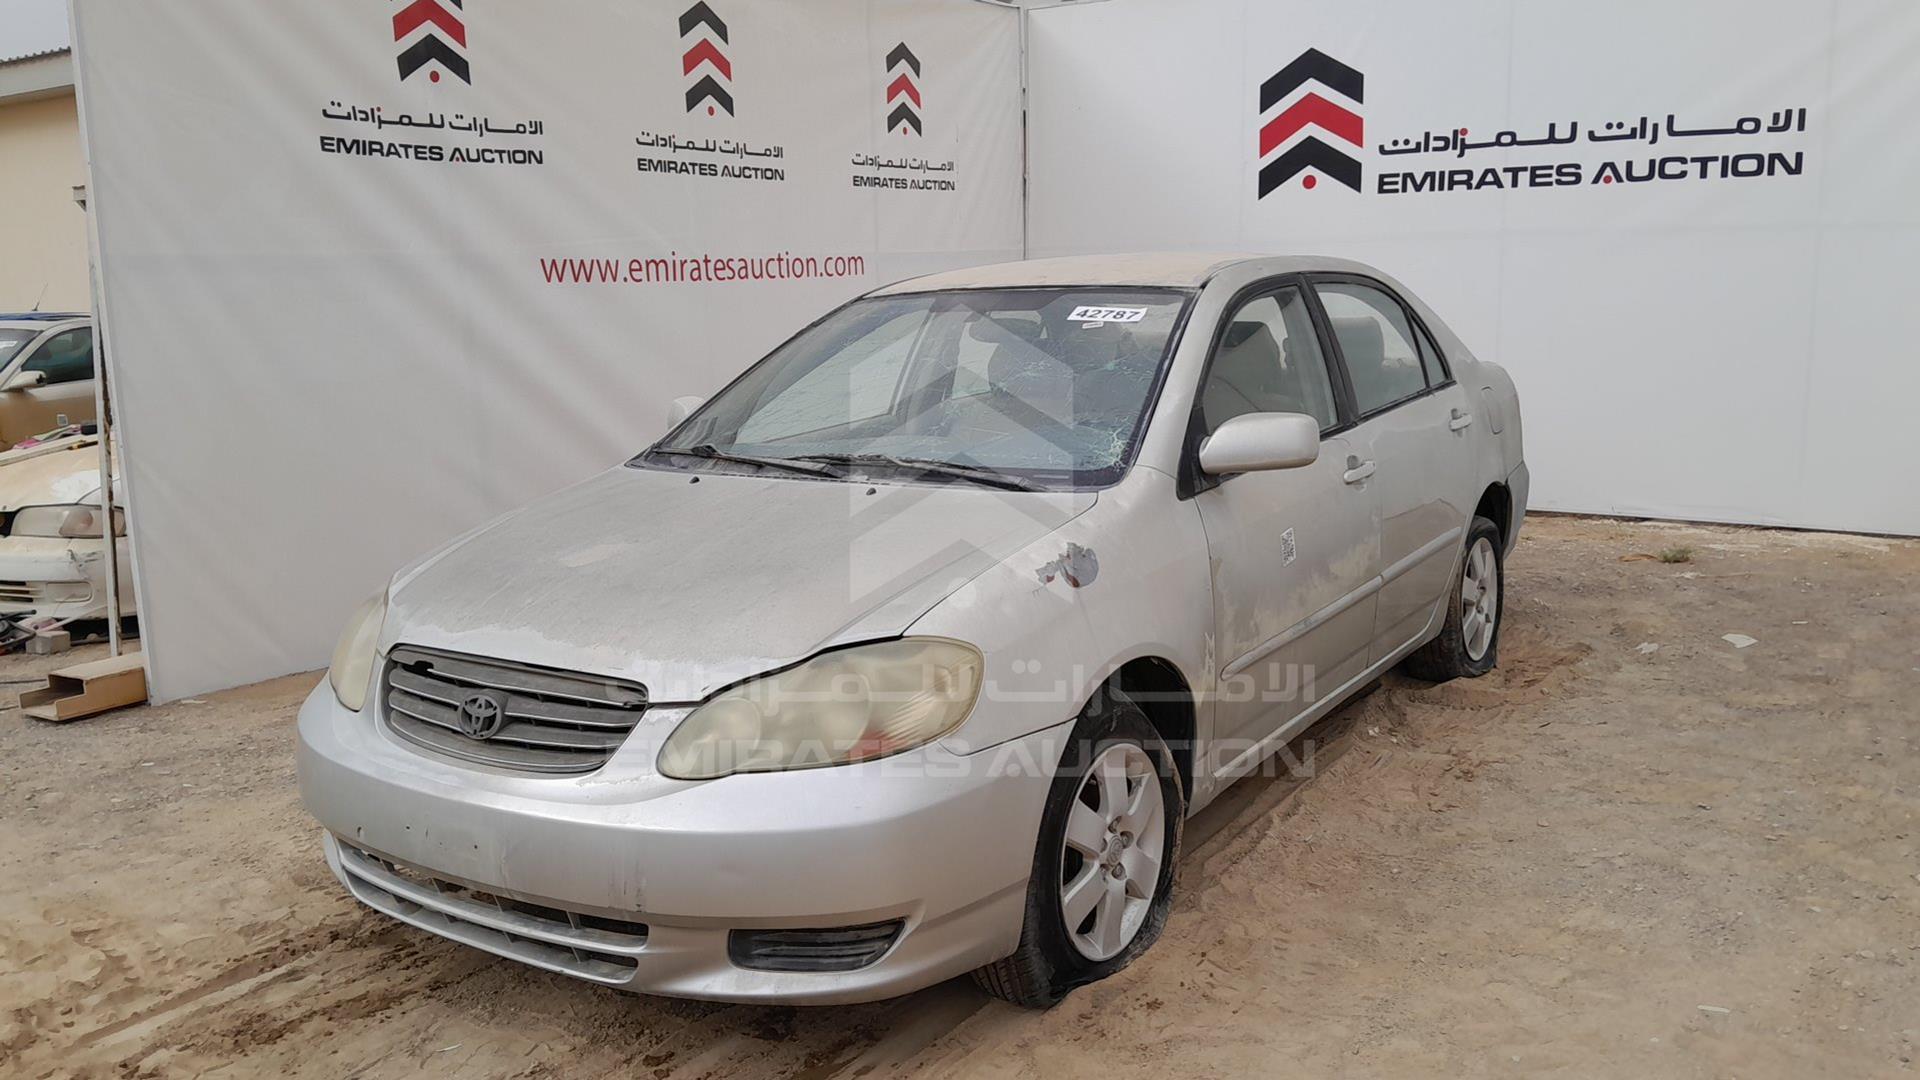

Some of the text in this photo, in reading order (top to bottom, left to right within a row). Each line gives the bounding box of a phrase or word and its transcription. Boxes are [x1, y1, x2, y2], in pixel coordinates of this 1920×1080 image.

[321, 100, 544, 137] الامارات للمزادات
[1378, 107, 1807, 158] الامارات للمزادات
[319, 135, 544, 165] EMIRATES AUCTION
[637, 157, 785, 181] EMIRATES AUCTION
[852, 175, 955, 191] EMIRATES AUCTION
[1377, 151, 1804, 195] EMIRATES AUCTION
[540, 250, 865, 283] www.emiratesauction.com
[1075, 308, 1141, 320] 42787
